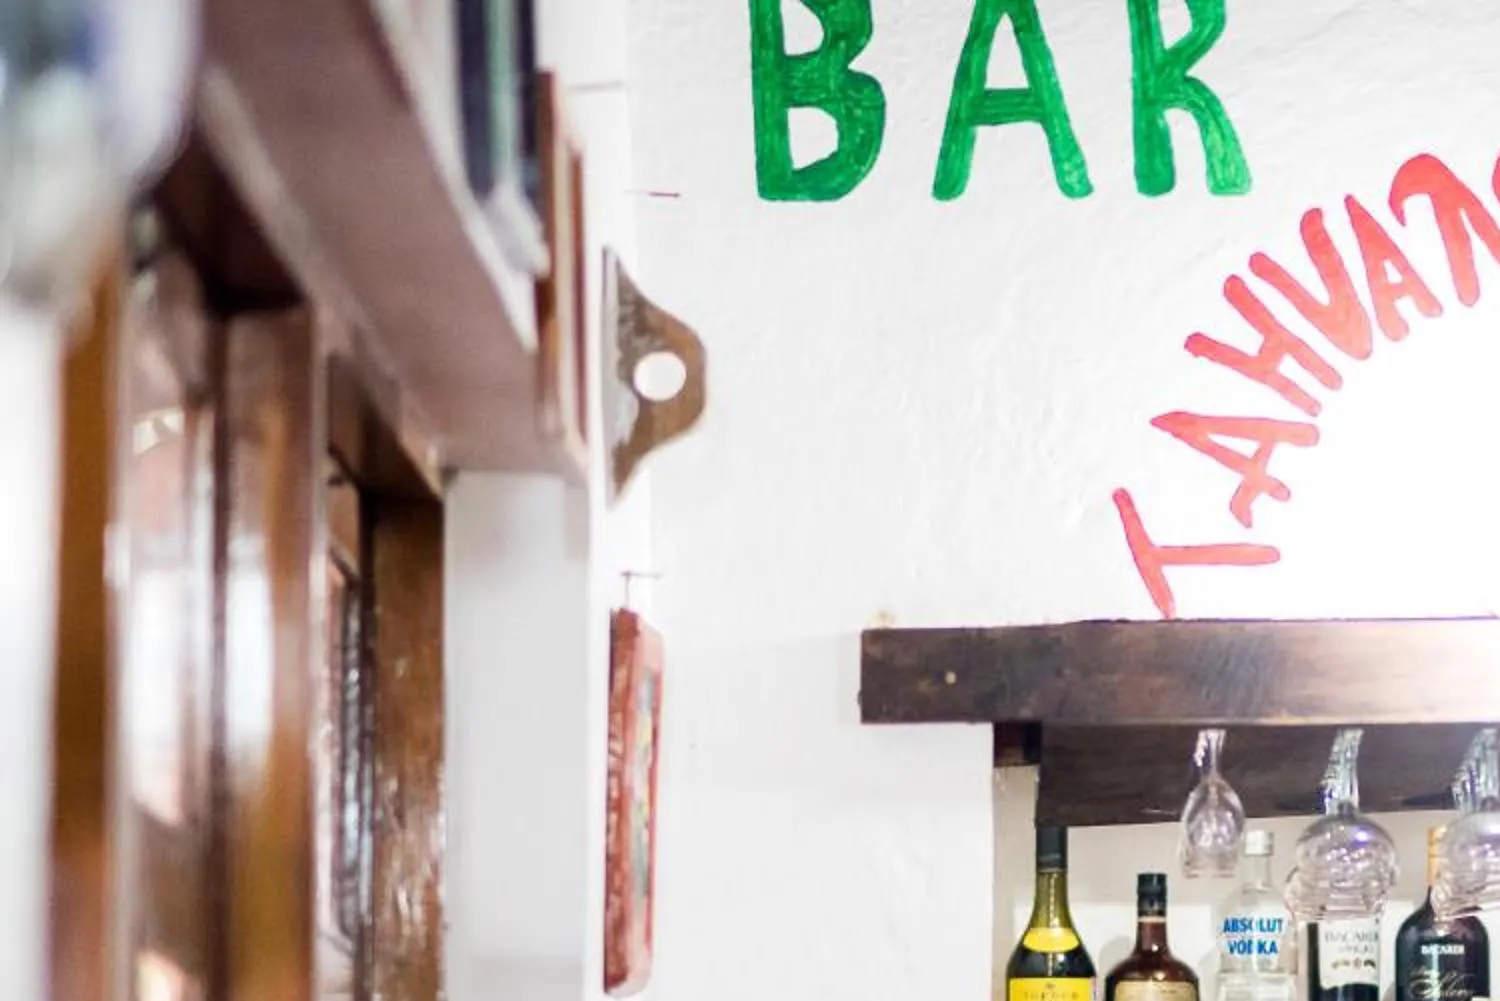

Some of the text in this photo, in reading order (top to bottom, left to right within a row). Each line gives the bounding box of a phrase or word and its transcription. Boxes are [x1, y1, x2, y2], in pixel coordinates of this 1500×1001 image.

[748, 0, 1254, 201] BAR
[1223, 918, 1284, 934] ABSOLUT
[1227, 939, 1279, 955] VODKA
